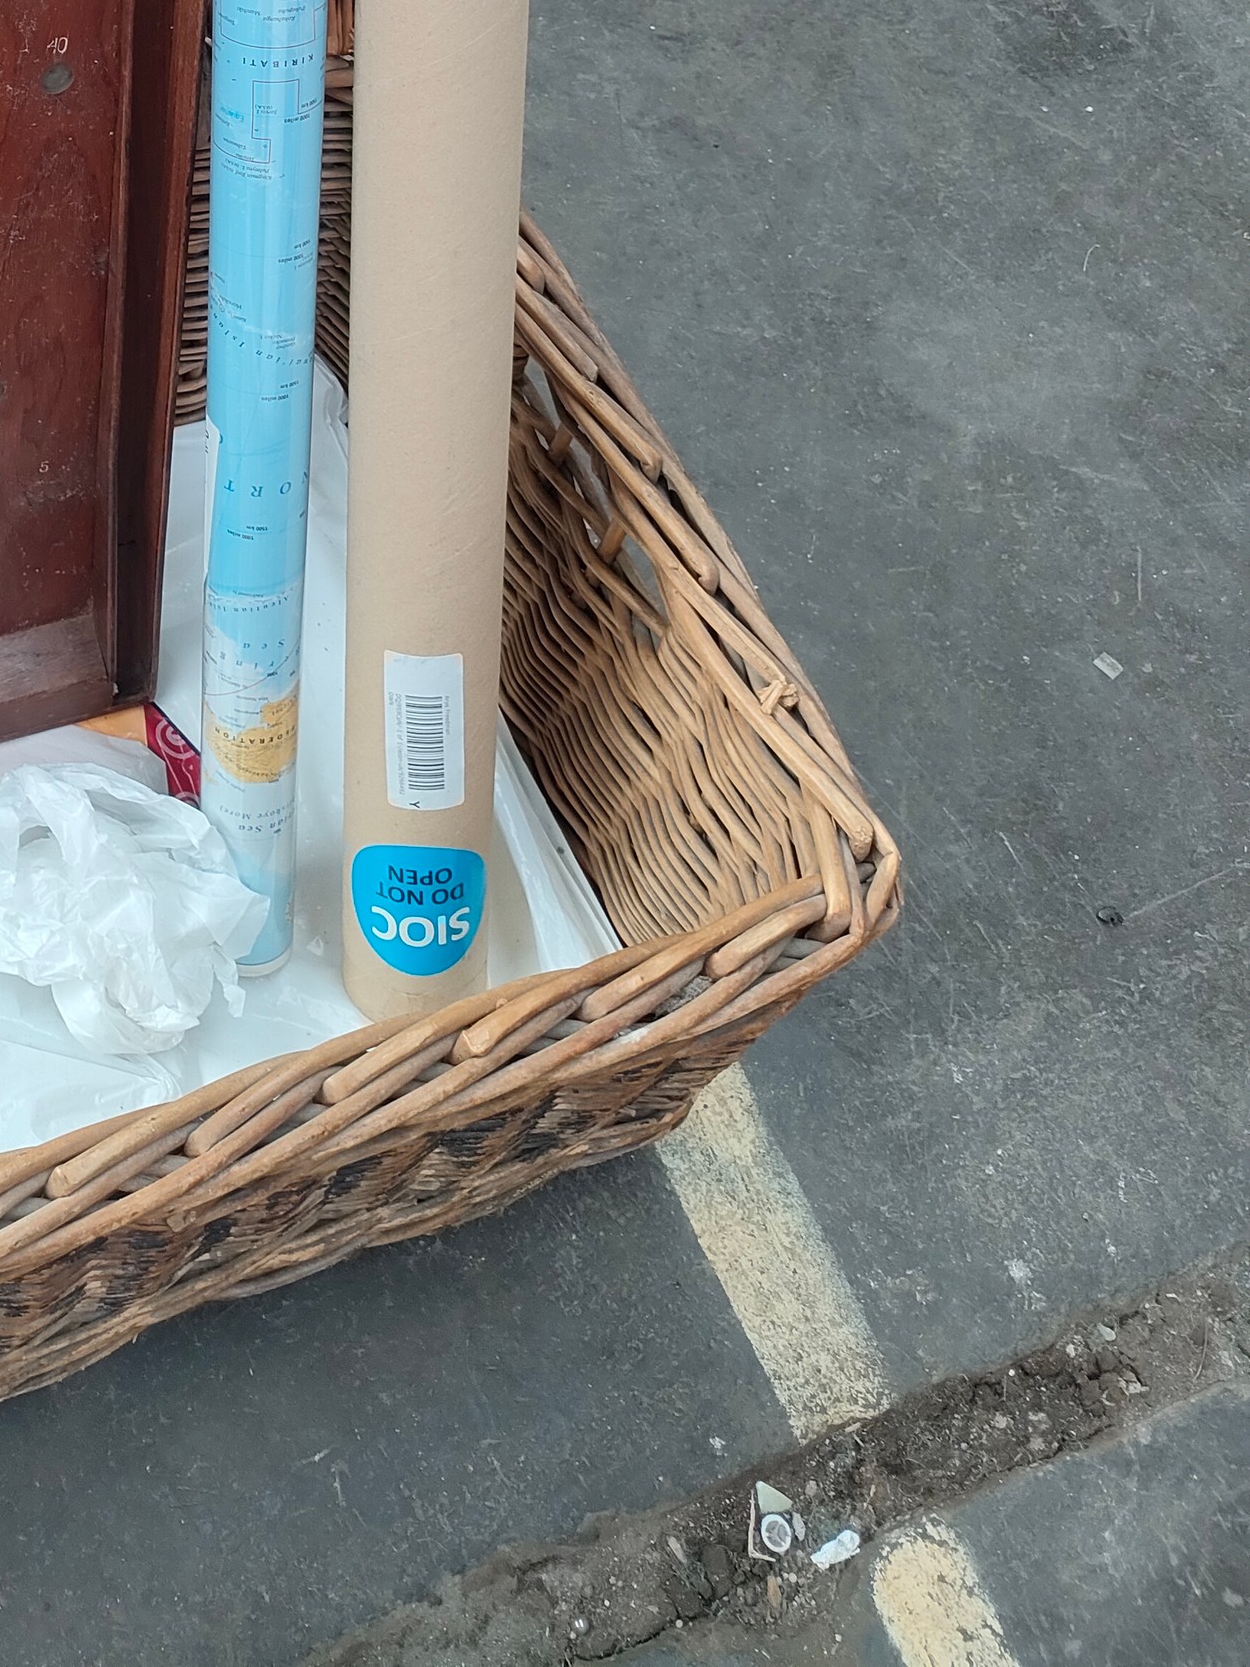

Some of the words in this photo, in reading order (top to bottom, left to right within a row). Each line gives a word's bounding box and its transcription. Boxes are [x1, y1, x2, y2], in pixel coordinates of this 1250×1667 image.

[47, 36, 69, 55] 40
[242, 54, 314, 68] KIRIBATI
[39, 460, 49, 473] 5
[409, 801, 420, 809] Y
[238, 825, 262, 833] Sea
[388, 865, 453, 886] OPEN
[375, 882, 424, 906] NOT
[431, 882, 464, 905] DO
[371, 905, 470, 947] SIOC
